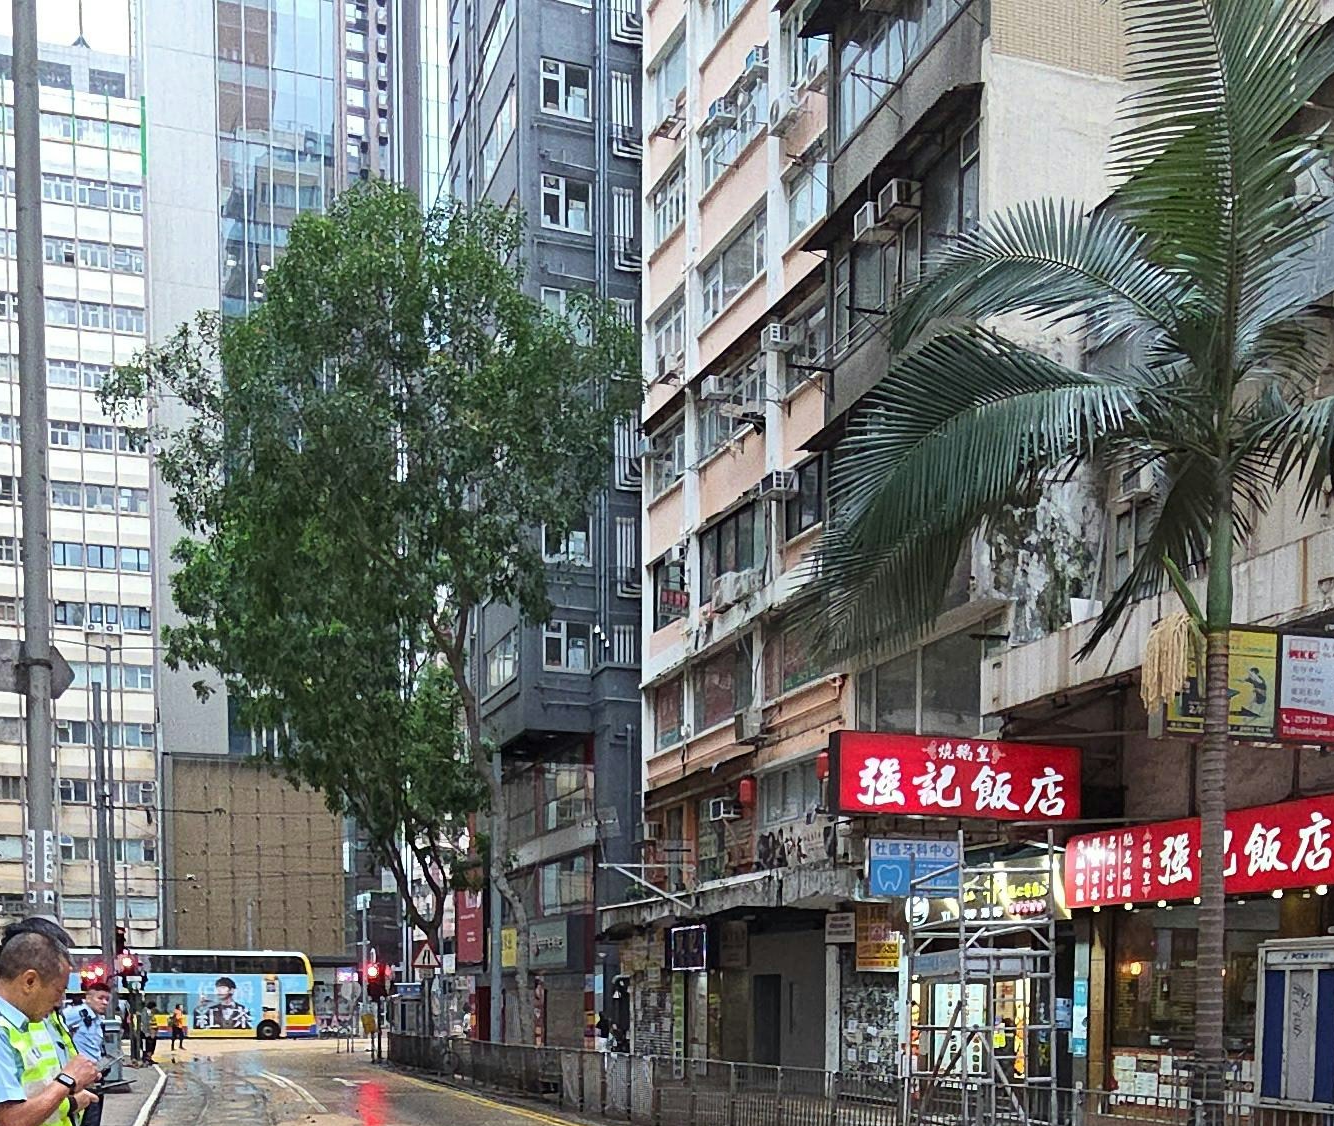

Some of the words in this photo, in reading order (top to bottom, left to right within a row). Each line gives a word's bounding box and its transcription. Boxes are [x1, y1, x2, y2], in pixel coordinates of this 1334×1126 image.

[857, 757, 1066, 817] 強記飯店
[875, 841, 955, 857] 社區牙科中心
[195, 1007, 253, 1029] 紅茶
